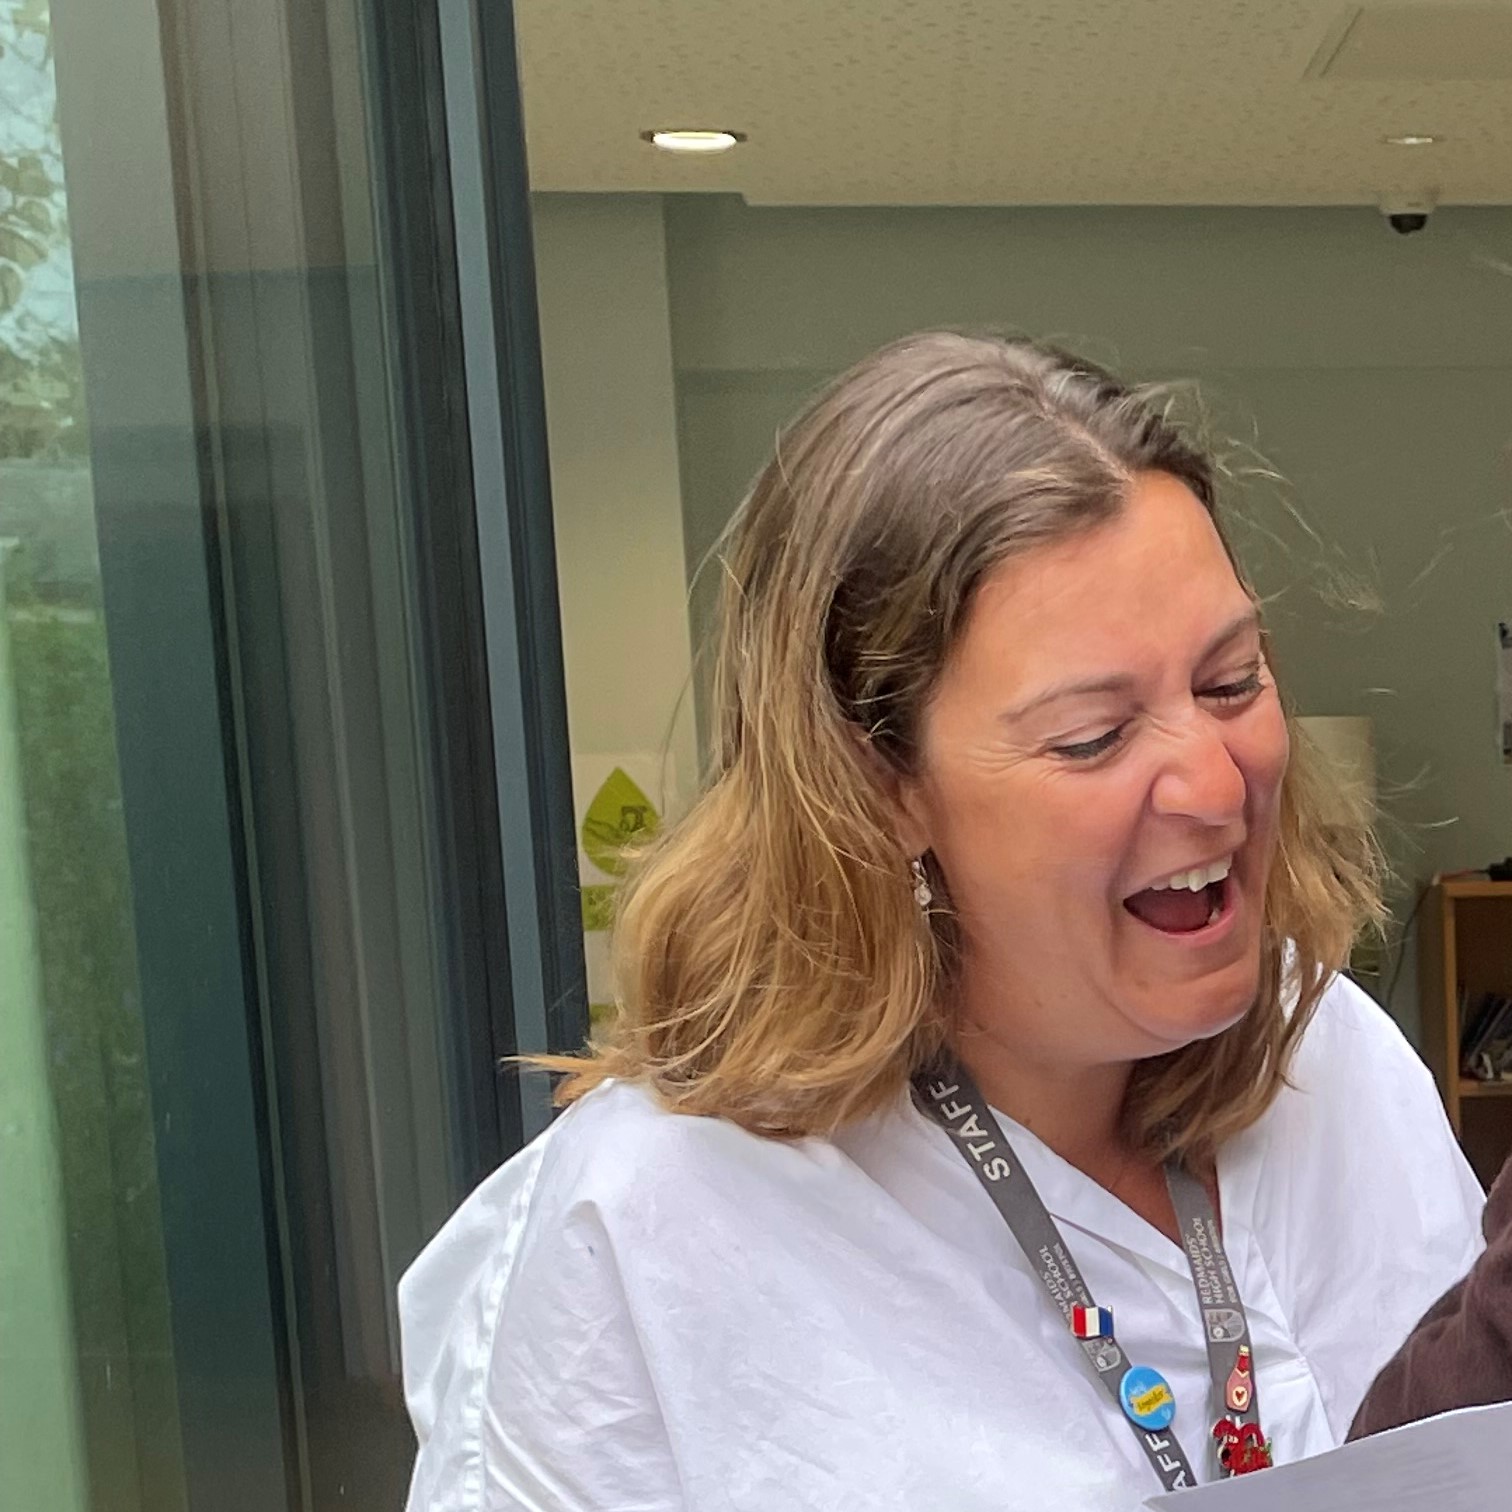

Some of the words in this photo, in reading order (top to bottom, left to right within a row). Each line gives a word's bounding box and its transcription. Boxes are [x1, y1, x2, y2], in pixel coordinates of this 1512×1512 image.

[929, 1081, 1011, 1181] STAFF
[1192, 1217, 1215, 1267] SCHOOL
[1039, 1244, 1074, 1299] SCHOOL
[1208, 1270, 1225, 1304] HIGH
[1145, 1433, 1187, 1490] AFF
